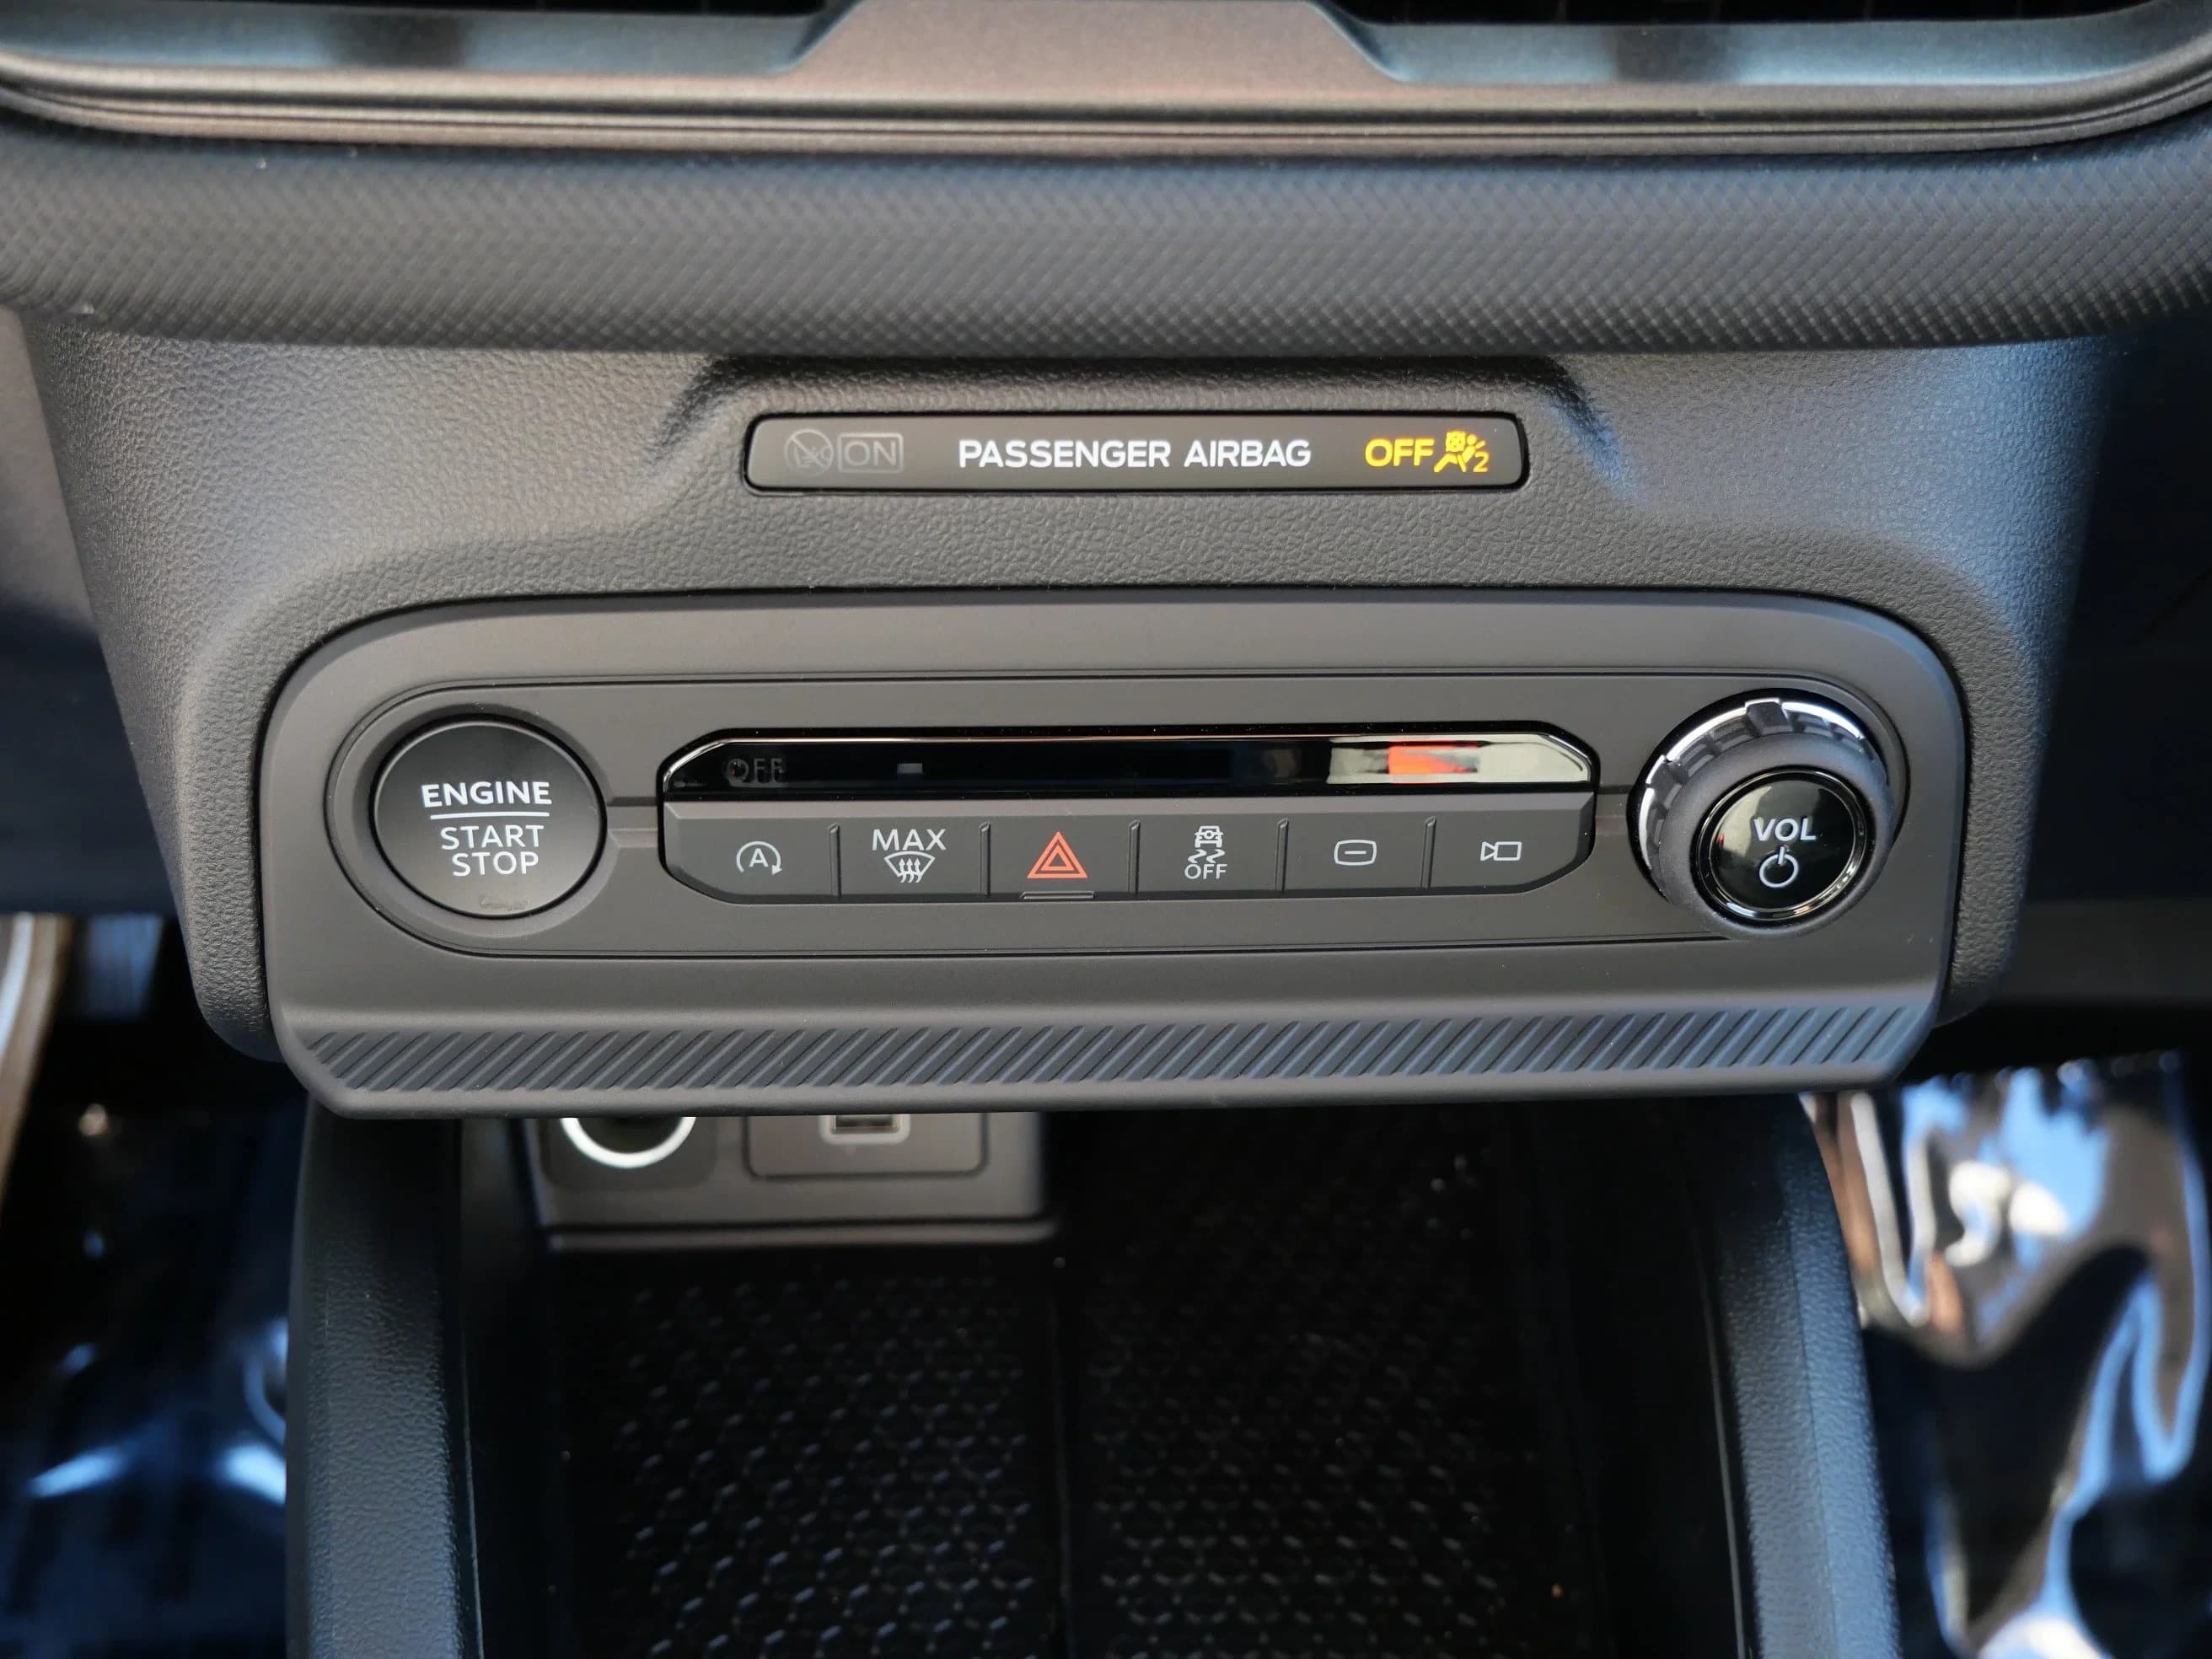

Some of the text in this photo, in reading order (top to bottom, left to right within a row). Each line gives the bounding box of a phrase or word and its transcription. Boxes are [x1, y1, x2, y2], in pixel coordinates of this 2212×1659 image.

[845, 441, 897, 466] ON
[958, 439, 1312, 469] PASSENGER AIRBAG
[1365, 438, 1490, 472] OFF 2
[421, 781, 552, 808] ENGINE
[441, 824, 544, 850] START
[872, 829, 947, 851] MAX
[1753, 816, 1816, 841] VOL
[452, 851, 539, 876] STOP
[749, 848, 769, 867] A
[1184, 863, 1227, 879] OFF
